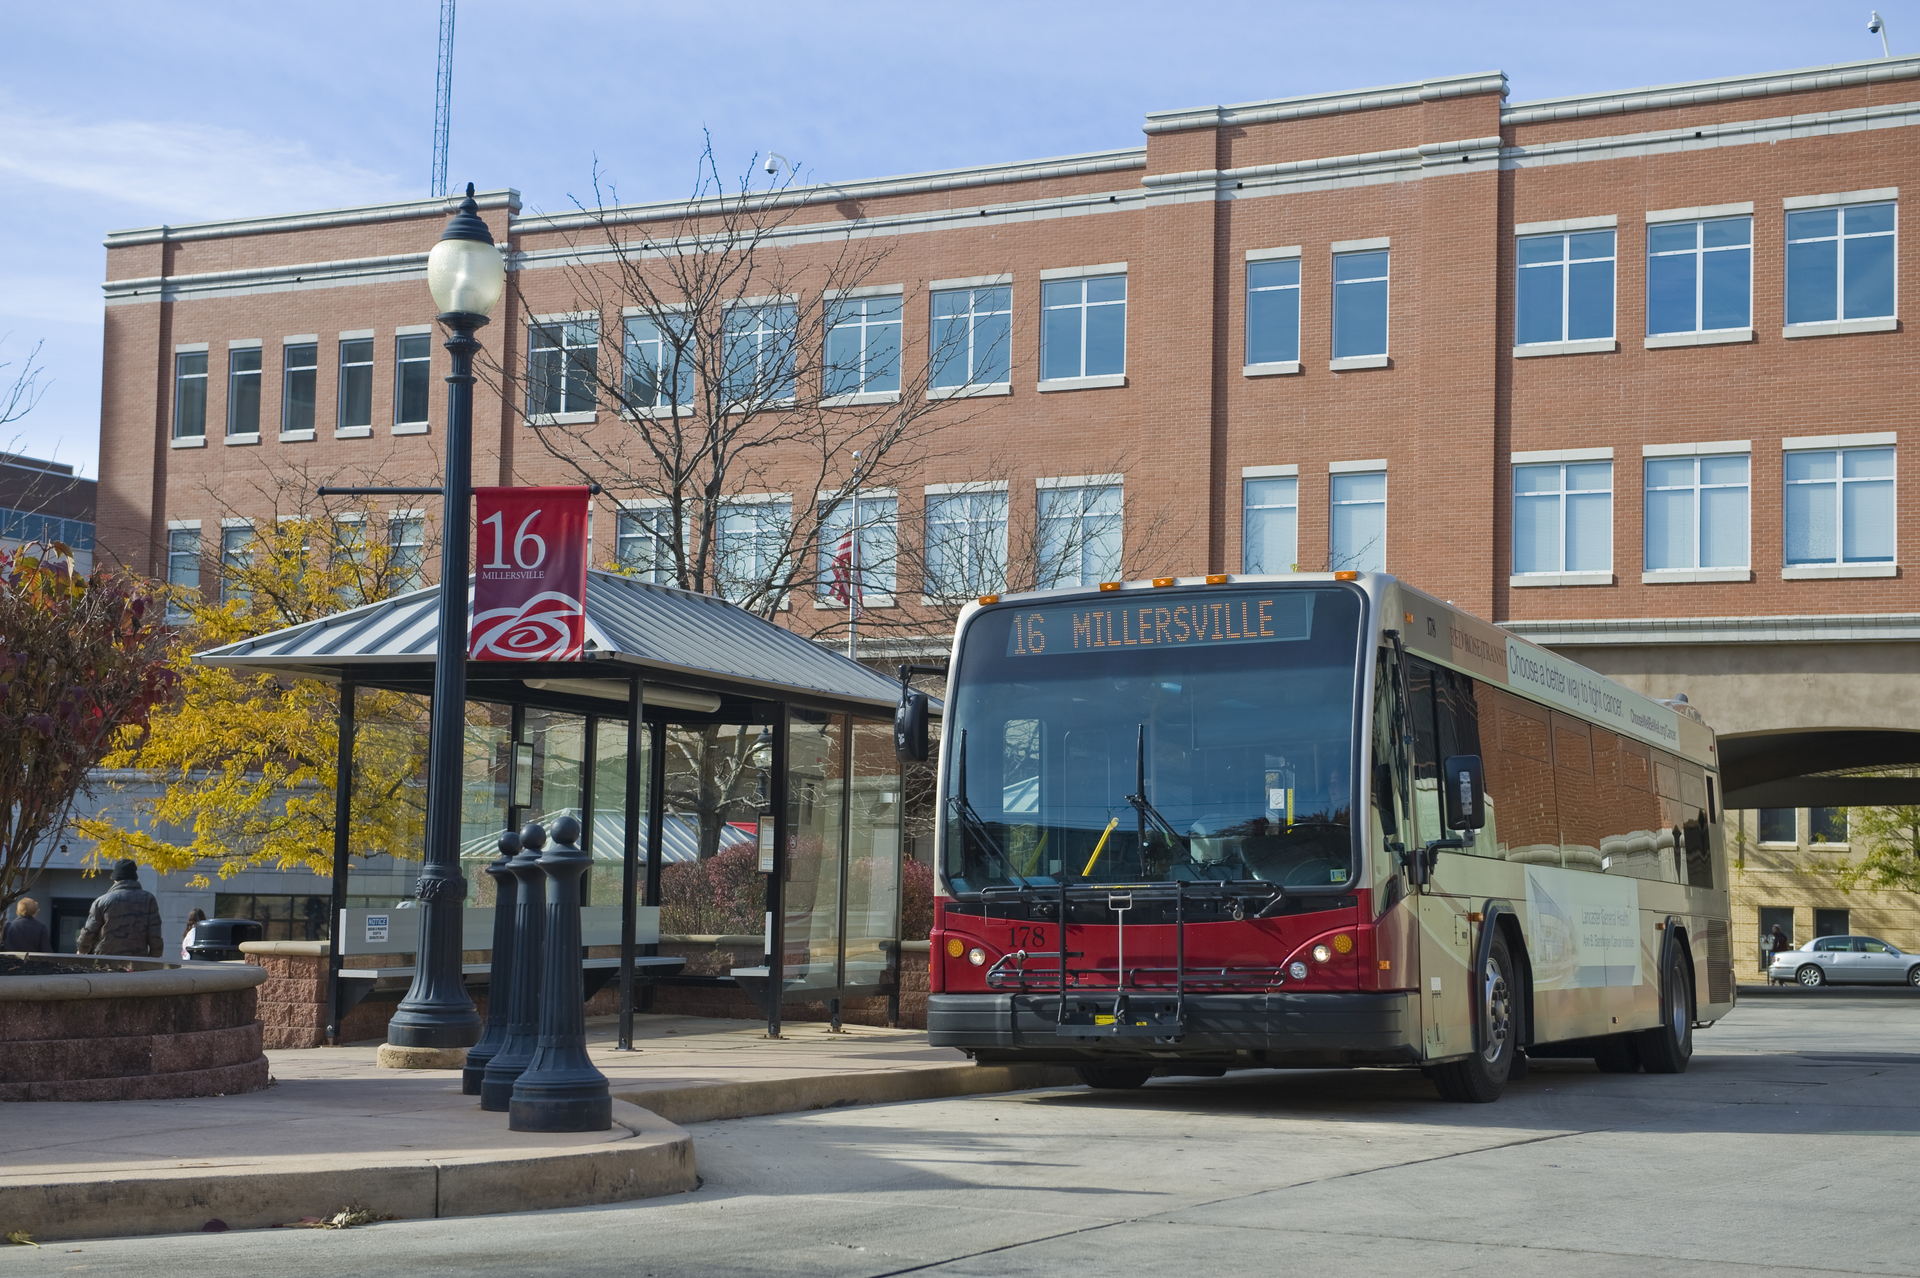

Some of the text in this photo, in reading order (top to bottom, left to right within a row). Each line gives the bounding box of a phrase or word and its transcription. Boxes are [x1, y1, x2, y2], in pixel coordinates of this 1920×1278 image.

[482, 509, 546, 569] 16
[482, 571, 545, 579] MILLERSVILLE
[1014, 600, 1275, 654] 16 MILLERSVILLE
[1426, 616, 1437, 638] 178
[1449, 626, 1507, 668] RED ROSE TRANSIT
[1509, 645, 1538, 682] Choose
[1540, 664, 1545, 685] a
[1545, 661, 1566, 693] better
[1566, 676, 1580, 706] way
[1581, 677, 1589, 704] to
[1589, 680, 1603, 713] fight
[1581, 907, 1630, 927] Lancaster General Health
[1008, 926, 1045, 948] 178
